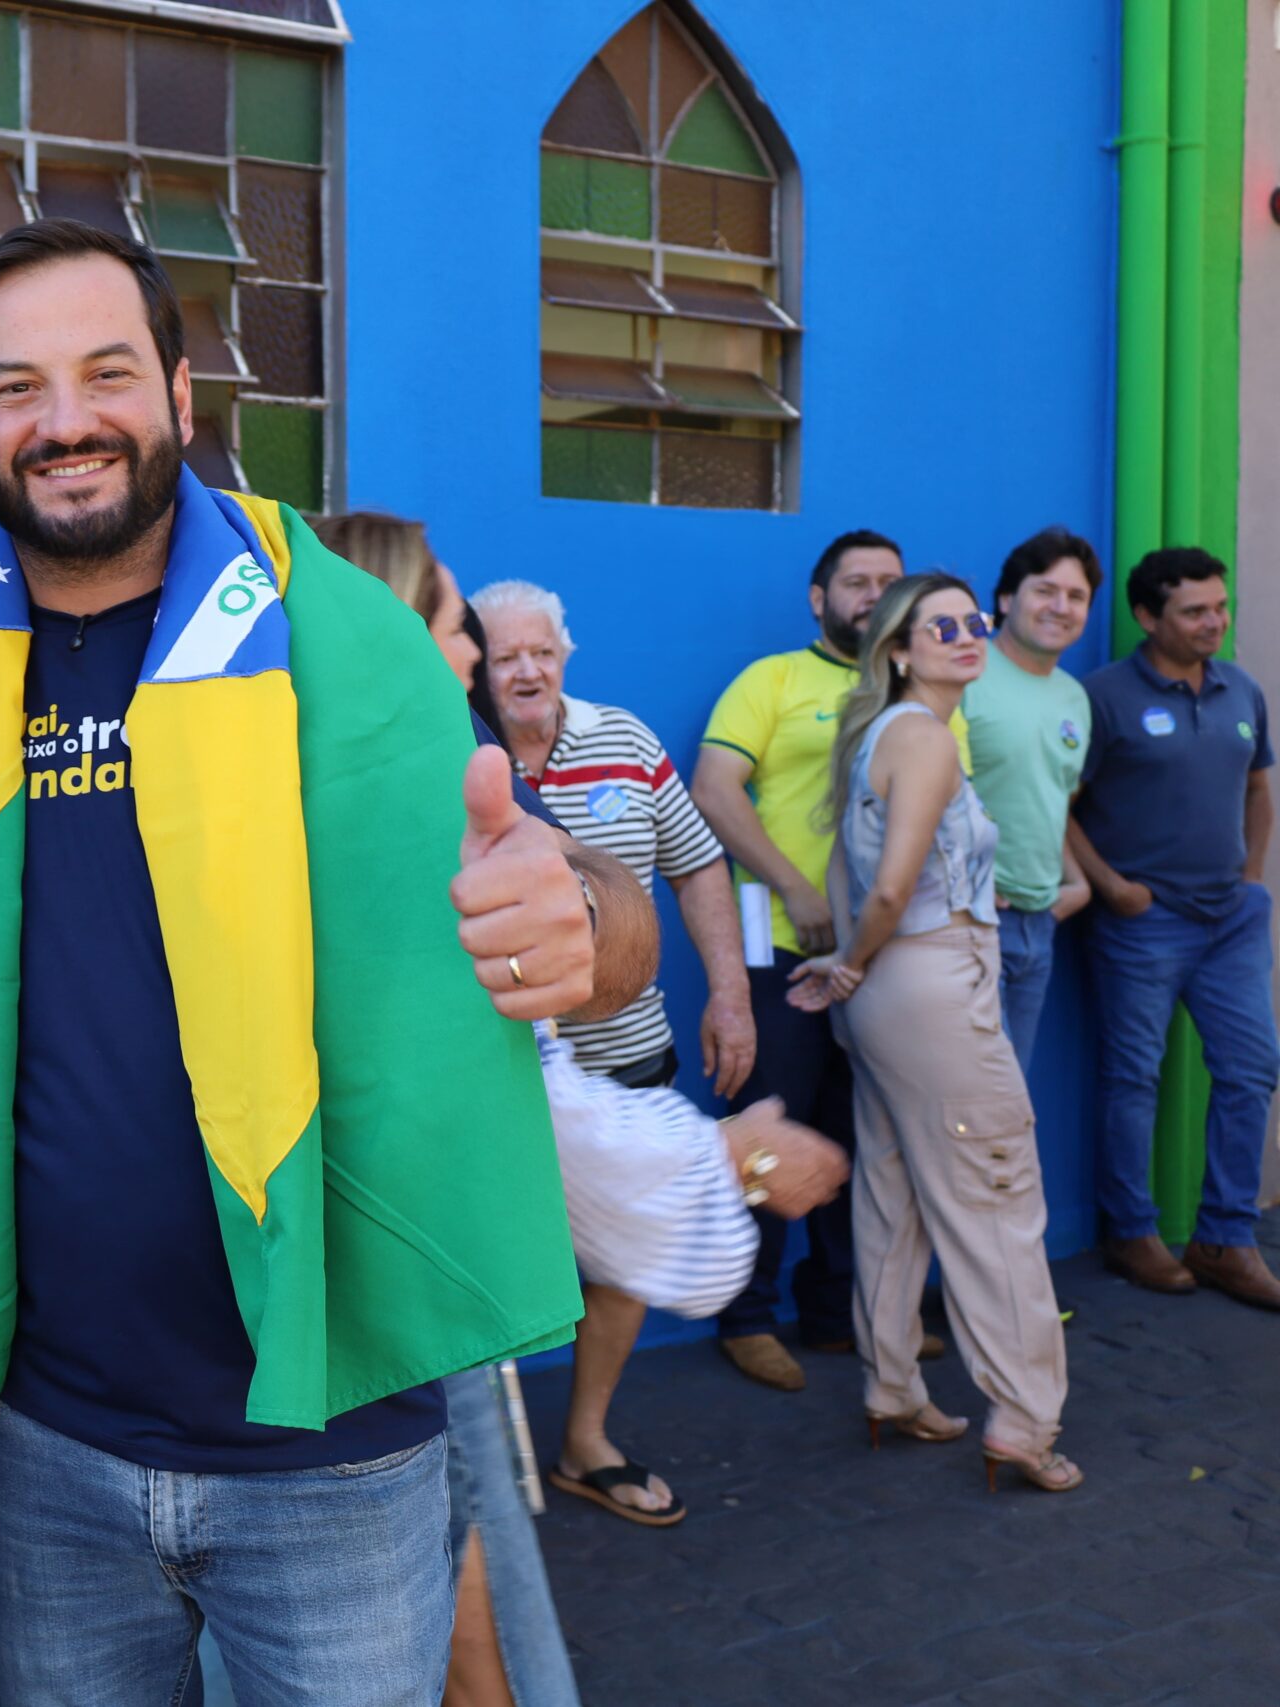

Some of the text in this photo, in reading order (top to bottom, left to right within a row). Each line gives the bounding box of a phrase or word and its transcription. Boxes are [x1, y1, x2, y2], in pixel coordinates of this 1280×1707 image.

[24, 703, 70, 738] ai,
[22, 738, 57, 759] eixa
[62, 738, 79, 754] o
[29, 752, 134, 800] nda
